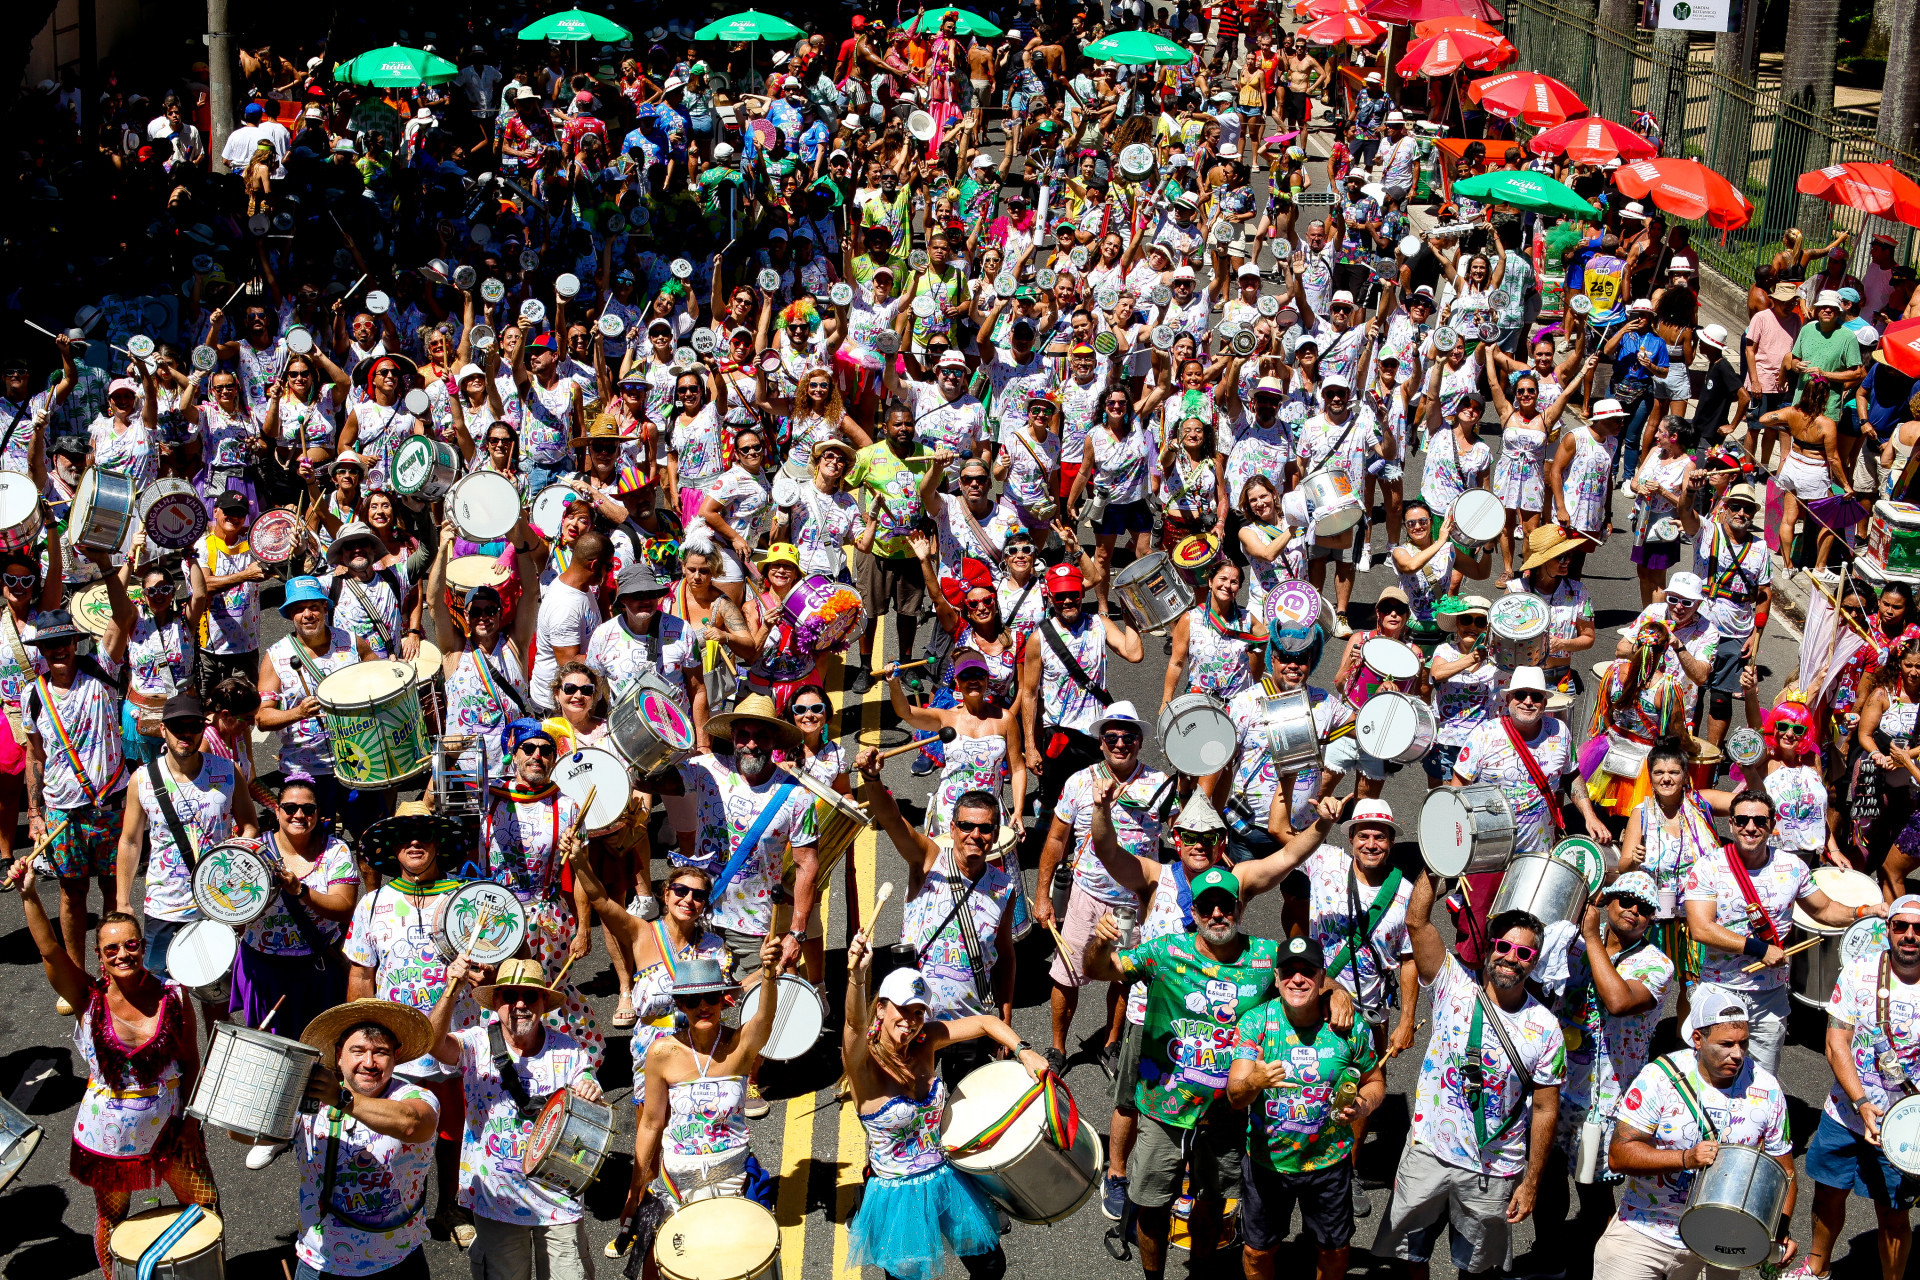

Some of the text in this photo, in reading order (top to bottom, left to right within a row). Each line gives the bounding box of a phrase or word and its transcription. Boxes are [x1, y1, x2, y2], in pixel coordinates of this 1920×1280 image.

[1480, 75, 1518, 91] BRAHMA
[1534, 83, 1549, 113] BRAHMA
[1590, 281, 1605, 292] Zé
[147, 496, 205, 546] ESCANGALHA ESCANGALHA
[1296, 582, 1321, 628] ESCANGALH
[1017, 620, 1036, 632] SER
[949, 770, 998, 789] VEM SER
[241, 858, 254, 873] ME
[484, 892, 498, 904] ME
[1850, 935, 1860, 947] ME
[388, 967, 421, 986] VEM
[389, 982, 444, 1008] CRIAN
[1214, 982, 1229, 993] ME
[1895, 1003, 1906, 1012] ME
[1177, 1019, 1236, 1049] VEM SE
[1852, 1034, 1876, 1050] VE
[1166, 1037, 1234, 1071] CRIAN
[1298, 1048, 1311, 1057] ME
[698, 1083, 711, 1092] ME
[1266, 1087, 1303, 1100] VEM
[1710, 1109, 1723, 1119] ME
[488, 1116, 525, 1140] VEM
[672, 1122, 731, 1144] VEM SER
[486, 1133, 529, 1159] CRIA
[358, 1170, 394, 1190] SER
[332, 1188, 402, 1212] RIANÇA
